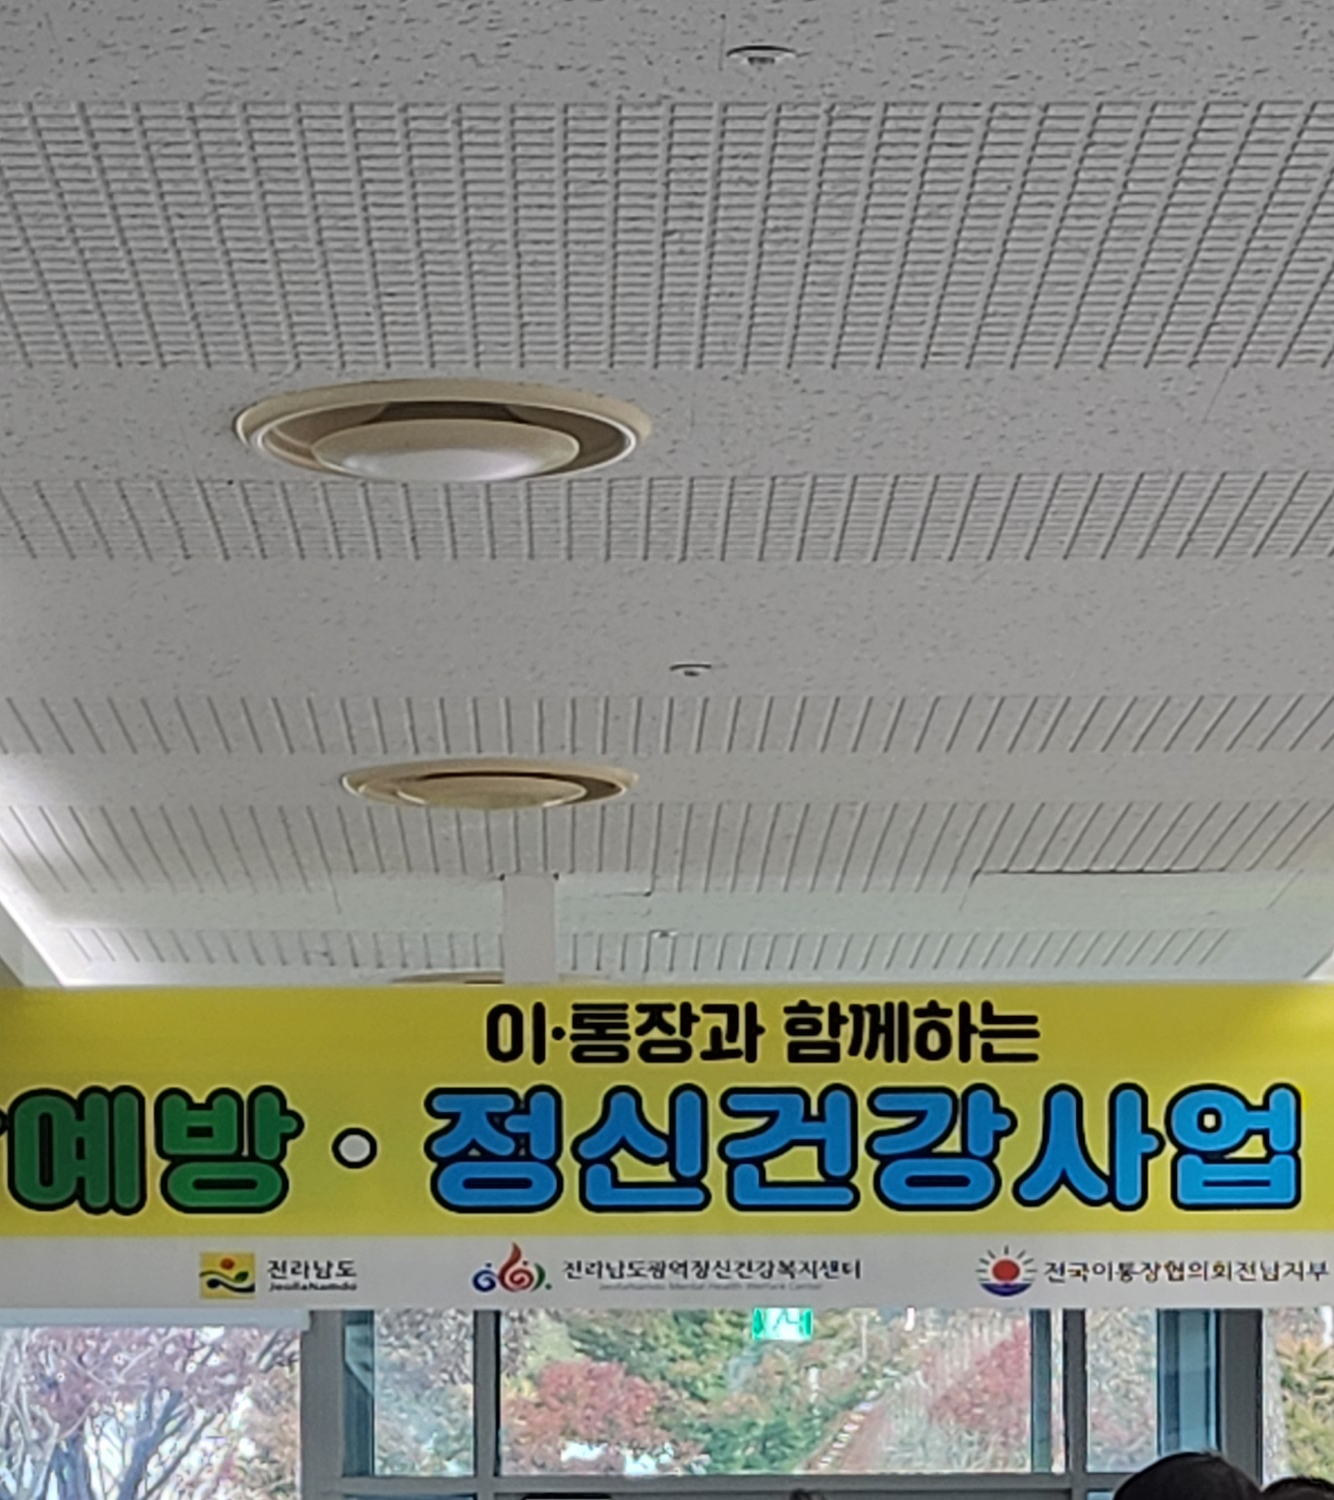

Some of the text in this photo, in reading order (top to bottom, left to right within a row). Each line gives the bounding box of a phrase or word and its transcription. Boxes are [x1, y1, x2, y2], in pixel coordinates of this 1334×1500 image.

[486, 1000, 1042, 1064] 이·통장과 함께하는
[267, 1258, 358, 1280] 전라남도
[563, 1258, 863, 1281] 전라남도광역정신건강복지센터
[1043, 1259, 1330, 1283] 전국이통장협의회전남지부
